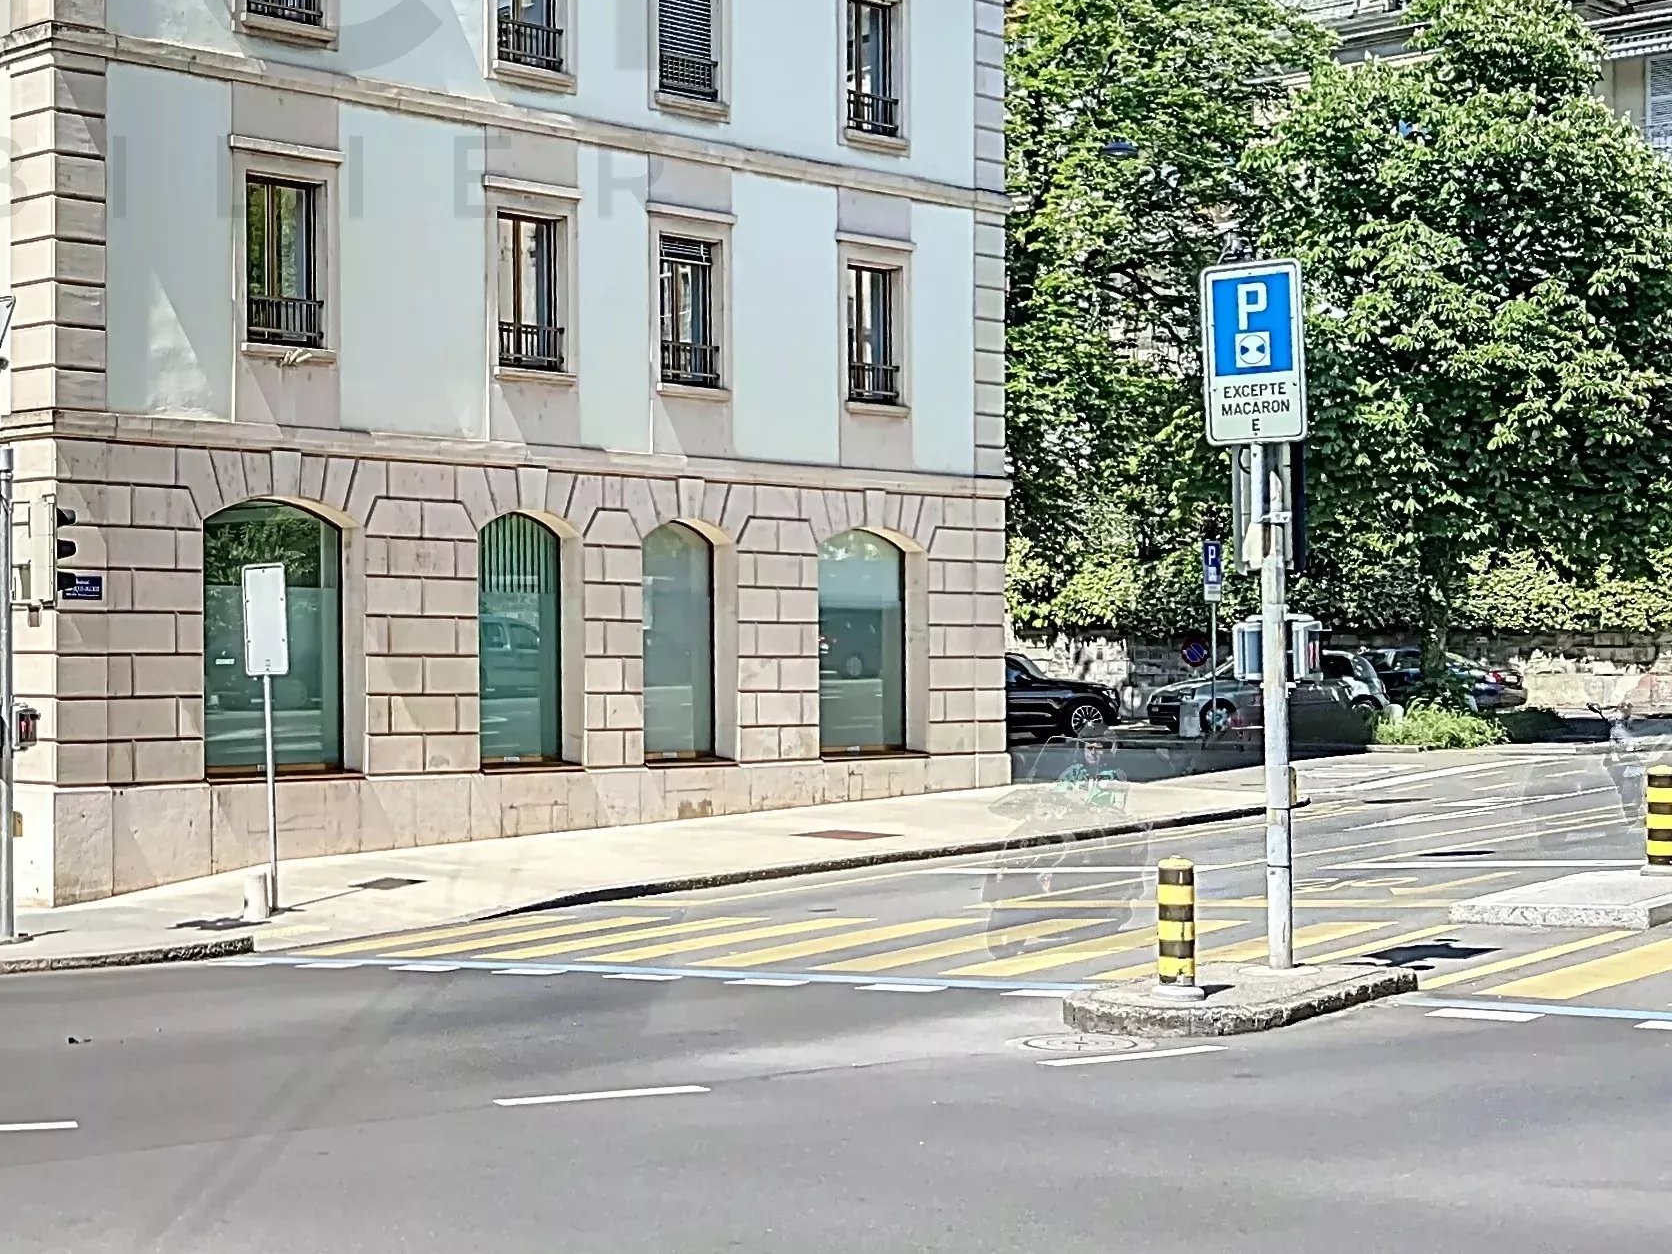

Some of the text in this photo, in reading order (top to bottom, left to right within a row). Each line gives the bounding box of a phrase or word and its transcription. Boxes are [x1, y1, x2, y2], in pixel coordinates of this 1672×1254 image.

[1236, 282, 1268, 330] P
[1223, 382, 1287, 399] EXCEPTE
[1221, 398, 1290, 416] MACARON
[1251, 418, 1260, 432] E
[1208, 545, 1216, 565] P
